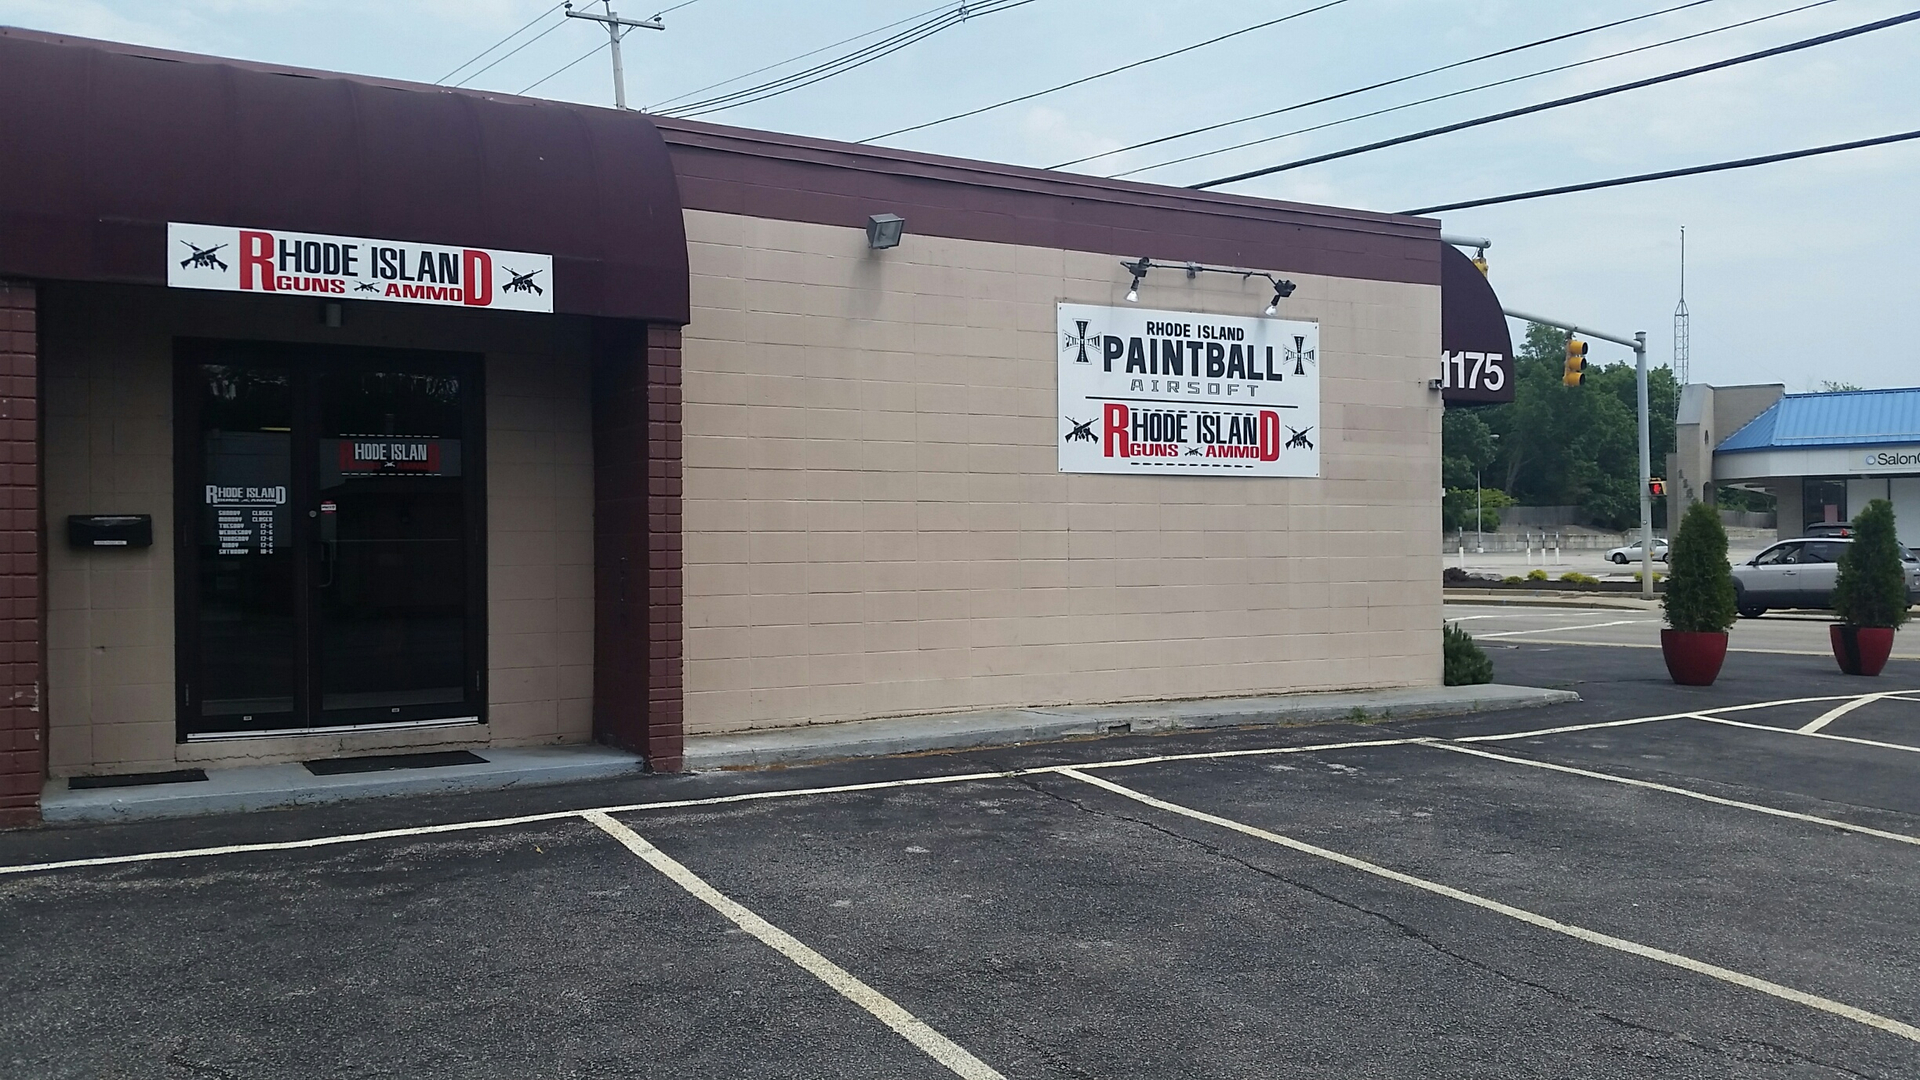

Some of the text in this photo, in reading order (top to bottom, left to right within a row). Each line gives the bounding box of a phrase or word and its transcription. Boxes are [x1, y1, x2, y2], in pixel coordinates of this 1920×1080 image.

[239, 230, 492, 306] RHODE ISLAND
[276, 275, 463, 302] GUNS AMMO
[1146, 321, 1245, 341] RHODE ISLAND
[1103, 335, 1283, 381] PAINTBALL
[1441, 350, 1505, 391] 1175
[1130, 379, 1259, 397] AIRSOFT
[1103, 403, 1280, 462] RHODE ISLAND
[1130, 443, 1260, 459] GUNS AMMO
[1877, 452, 1920, 466] Salon
[205, 484, 287, 505] RHODE ISLAND
